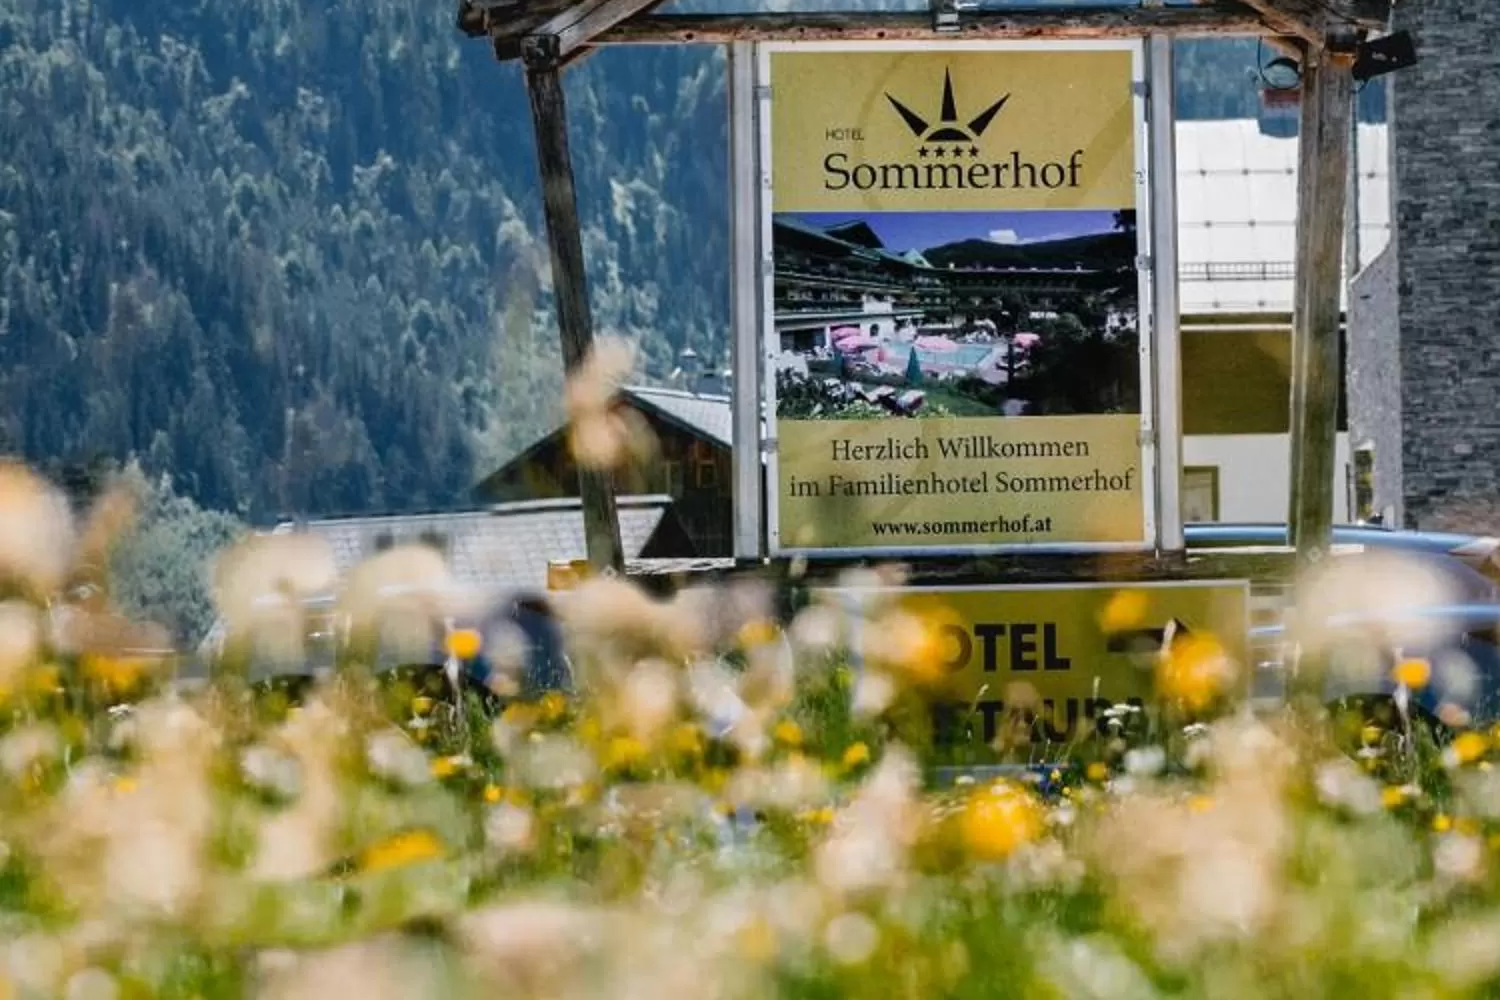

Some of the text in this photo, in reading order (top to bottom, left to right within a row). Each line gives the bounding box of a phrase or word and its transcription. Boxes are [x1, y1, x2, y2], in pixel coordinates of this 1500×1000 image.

[825, 128, 864, 141] HOTEL
[823, 150, 1083, 190] Sommerhof
[831, 435, 1090, 461] Herzlich Willkommen
[790, 468, 1133, 497] im Familienhotel Sommerhof
[872, 515, 1052, 535] www.sommerhof.at
[915, 622, 1071, 672] OTEL
